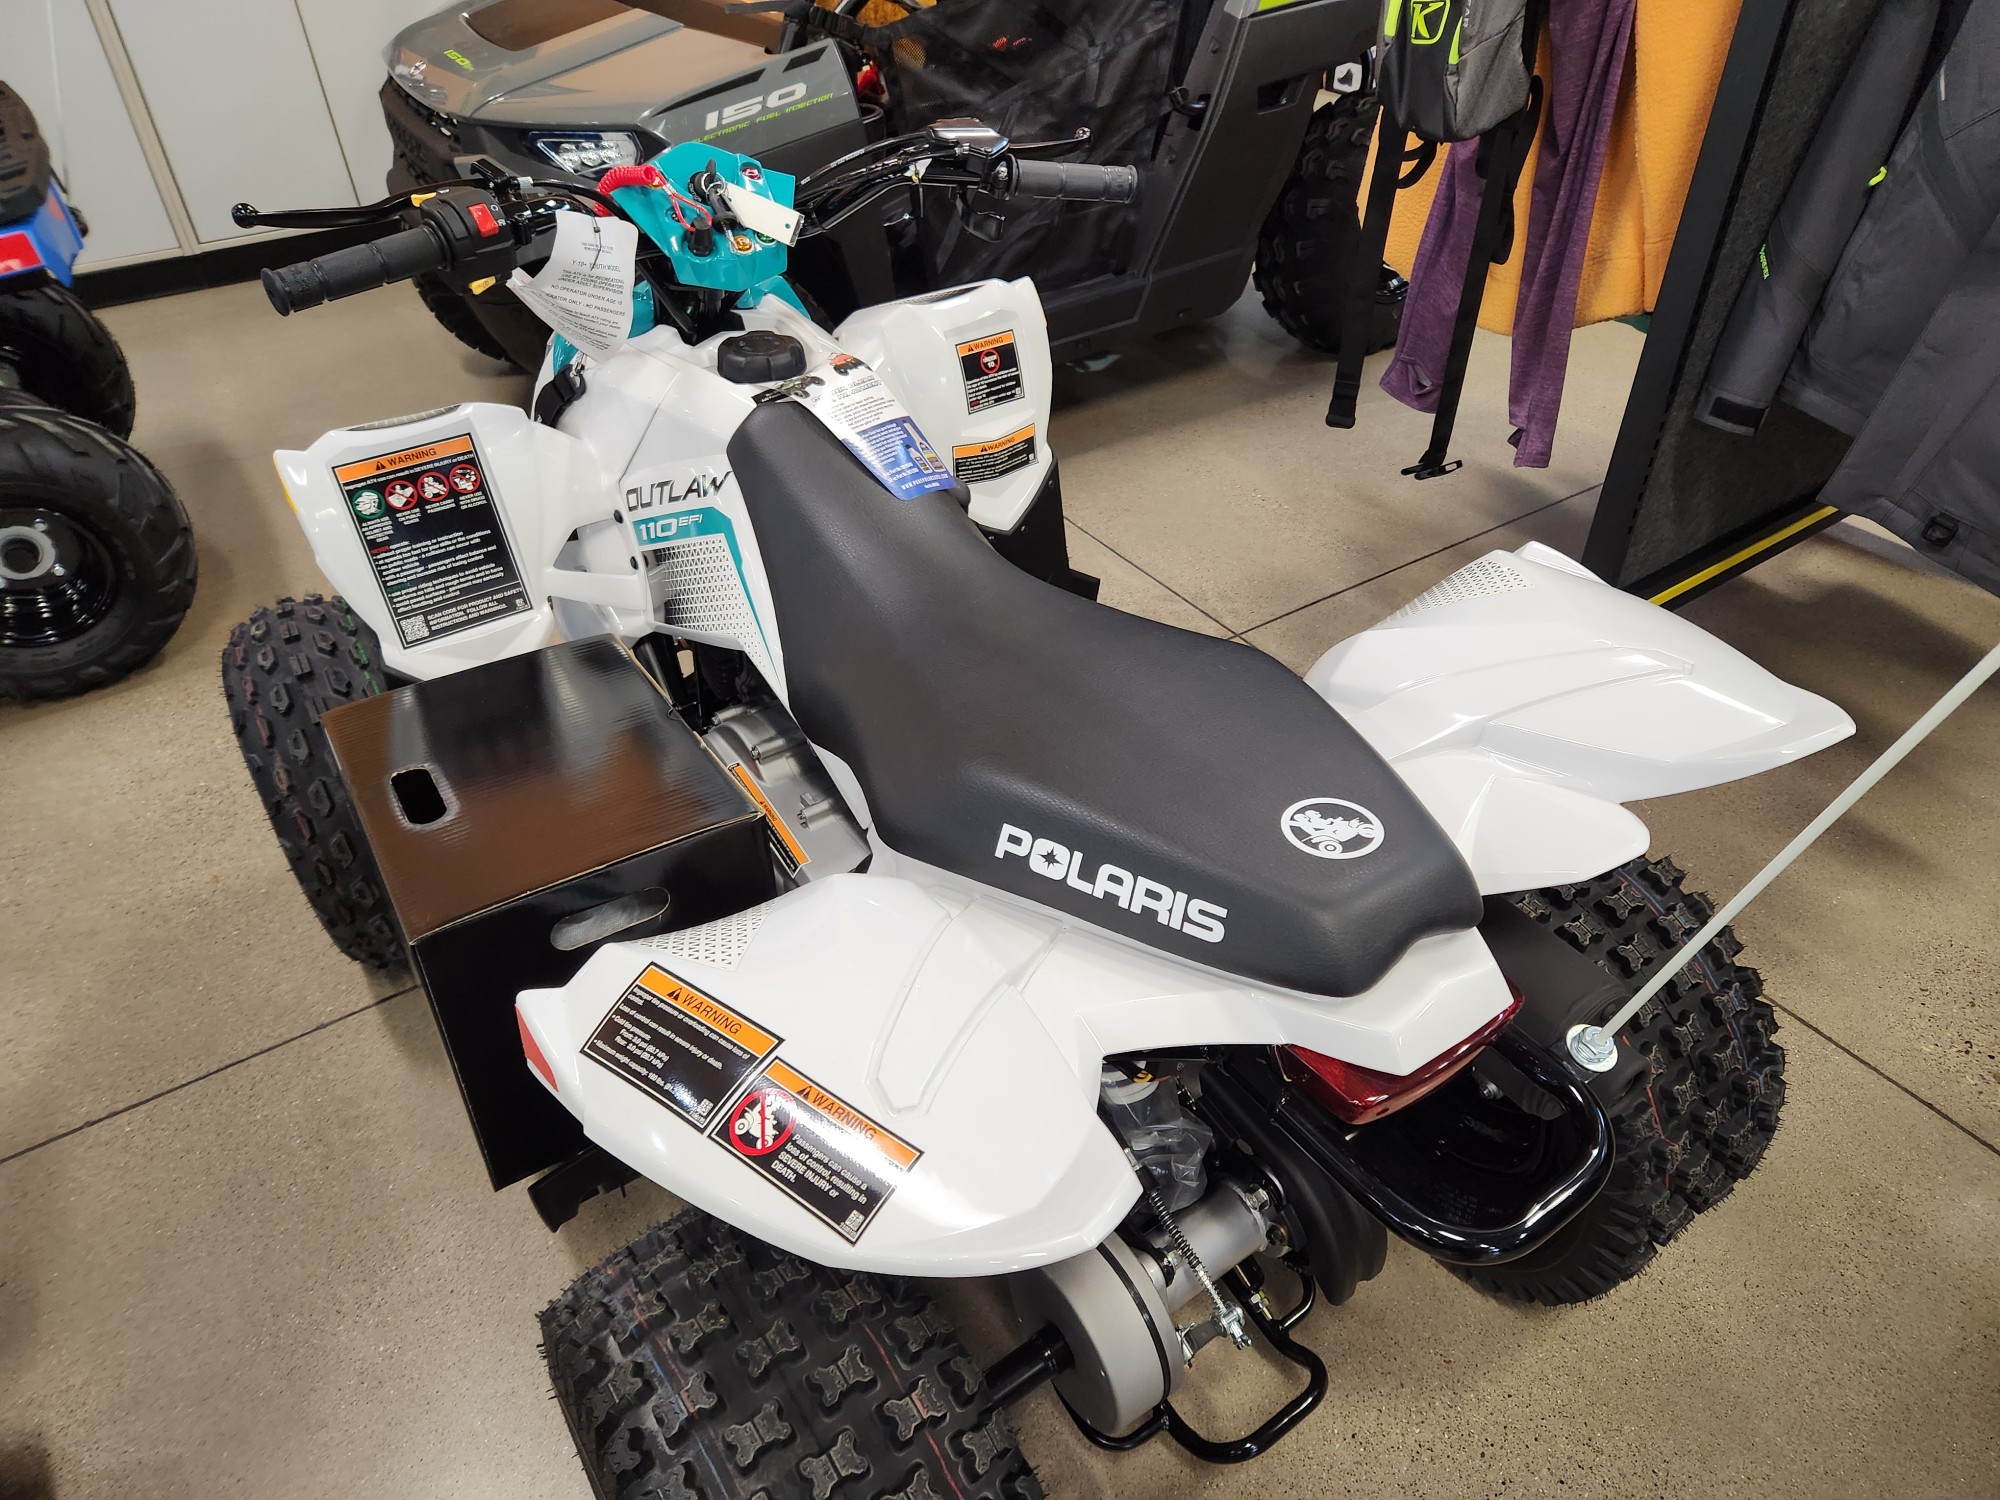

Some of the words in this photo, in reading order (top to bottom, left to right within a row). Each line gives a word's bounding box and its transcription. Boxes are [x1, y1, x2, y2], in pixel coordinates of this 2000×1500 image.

[705, 83, 807, 130] 150
[756, 112, 781, 123] FUEL
[786, 93, 833, 113] INJECTION
[560, 287, 587, 296] OPERATOR
[588, 293, 605, 301] UNDER
[974, 337, 1003, 349] WARNING
[388, 449, 436, 465] WARNING
[988, 438, 1015, 450] WARNING
[626, 471, 733, 512] OUTLAW
[639, 518, 678, 540] 110
[678, 514, 703, 526] EFI
[763, 804, 778, 821] WARNING
[995, 824, 1228, 942] POLARIS
[683, 995, 741, 1033] WARNING
[813, 1093, 876, 1137] WARNING
[772, 1161, 796, 1182] DEATH.
[779, 1152, 806, 1174] SEVERE
[805, 1170, 831, 1191] INJURY
[829, 1189, 839, 1197] or
[785, 1143, 800, 1156] loss
[799, 1153, 809, 1161] of
[806, 1159, 831, 1179] control,
[831, 1176, 859, 1199] resulting
[858, 1194, 867, 1204] in
[793, 1134, 829, 1162] Passengers
[828, 1159, 843, 1172] can
[841, 1168, 864, 1185] cause
